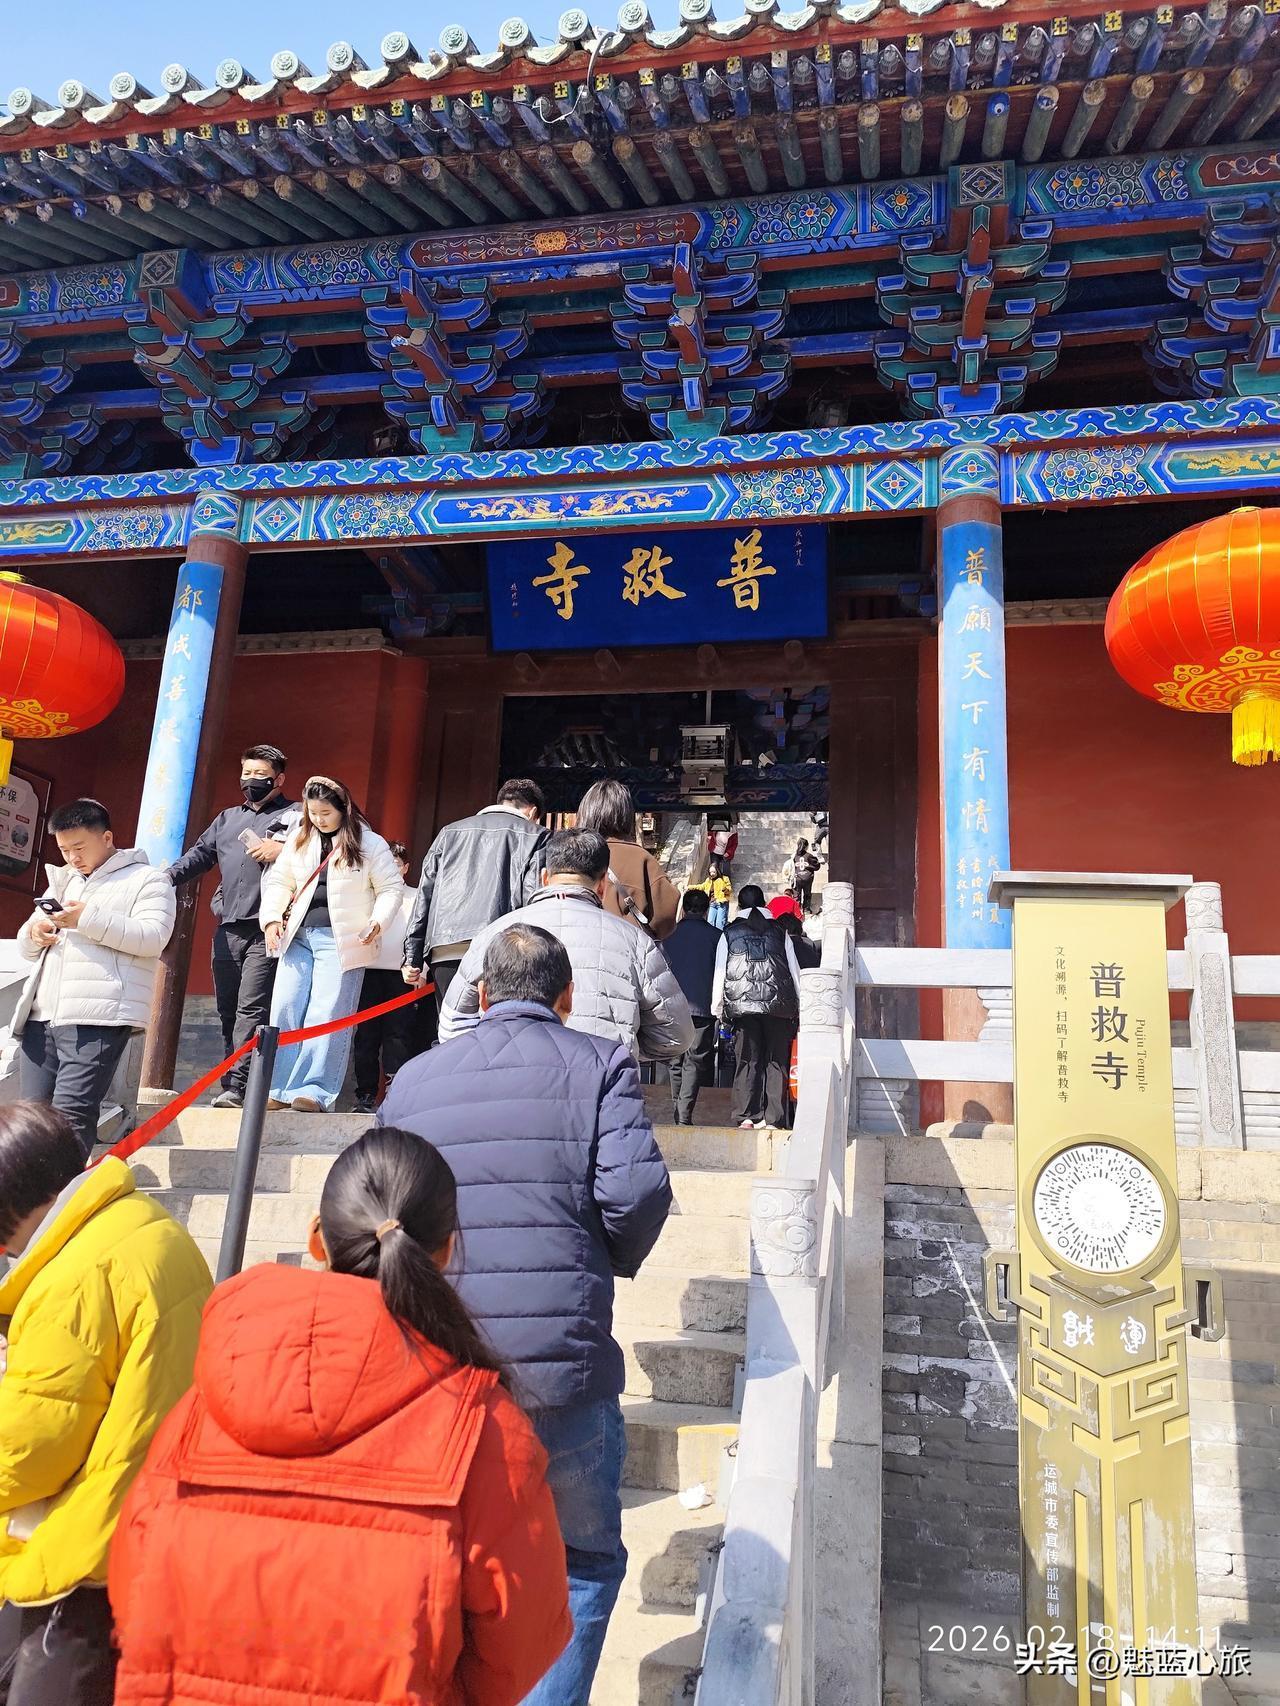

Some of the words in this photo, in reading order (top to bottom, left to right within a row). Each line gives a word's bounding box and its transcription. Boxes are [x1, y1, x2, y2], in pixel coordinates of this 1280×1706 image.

[532, 529, 777, 620] 普救寺
[1089, 961, 1130, 1091] 普救寺
[1135, 1018, 1146, 1048] Pujiu
[1136, 1050, 1148, 1093] Temple
[1044, 1463, 1060, 1618] 运城市委宣传部监制
